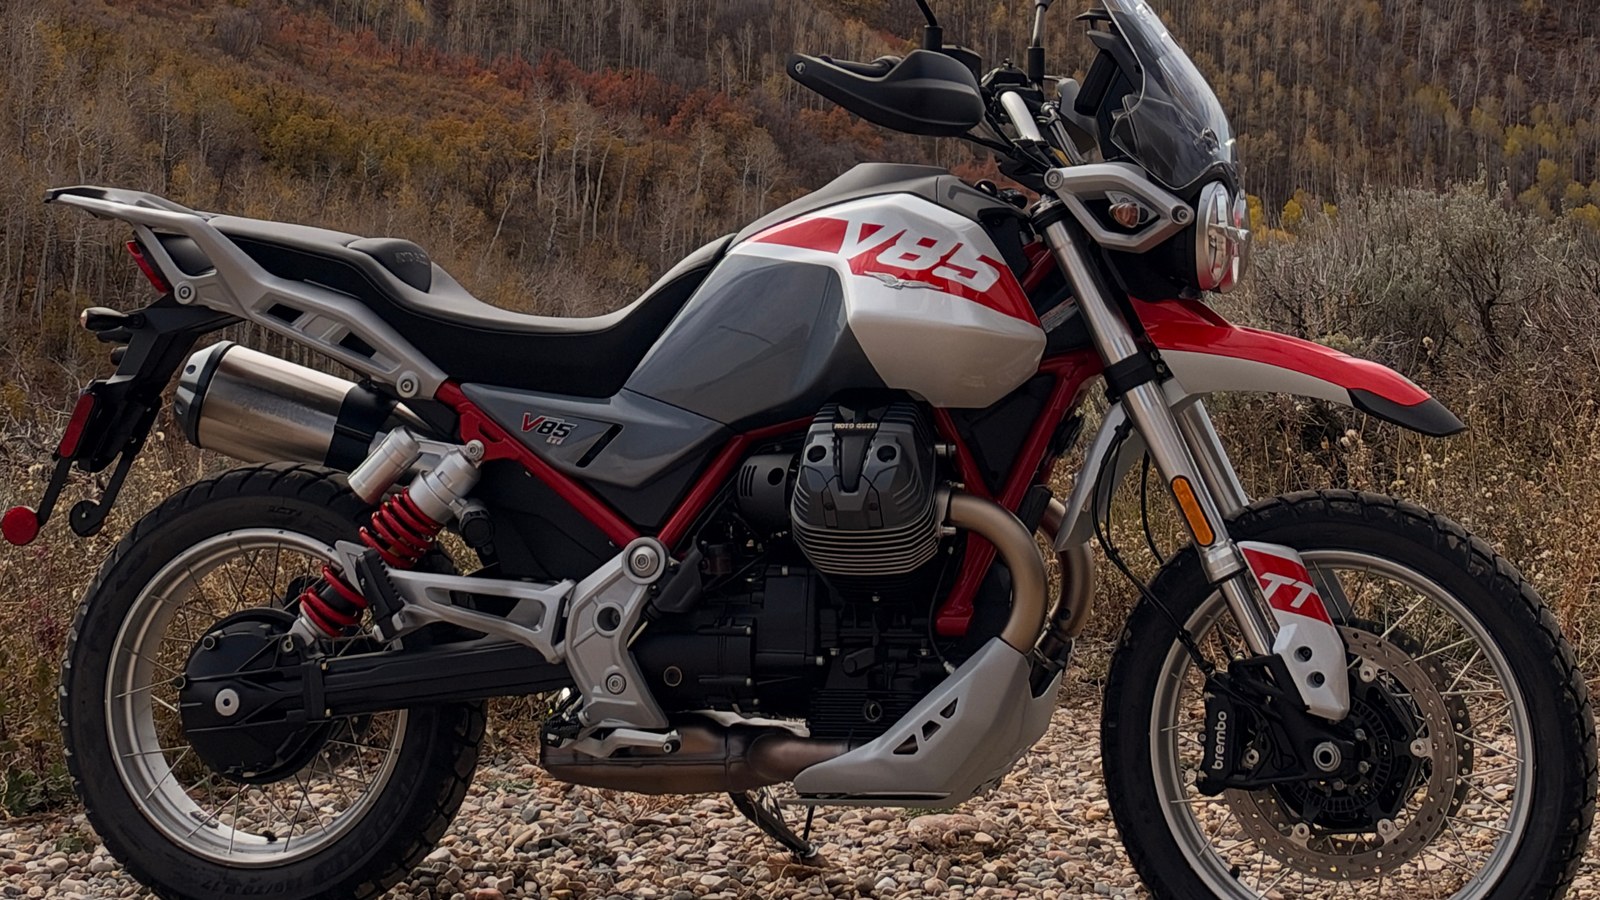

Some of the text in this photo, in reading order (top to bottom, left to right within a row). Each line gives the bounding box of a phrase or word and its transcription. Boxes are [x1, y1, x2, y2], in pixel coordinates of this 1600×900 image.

[838, 219, 1001, 292] V85
[521, 412, 578, 437] V85
[1260, 572, 1319, 609] TT
[1211, 710, 1228, 770] brembo
